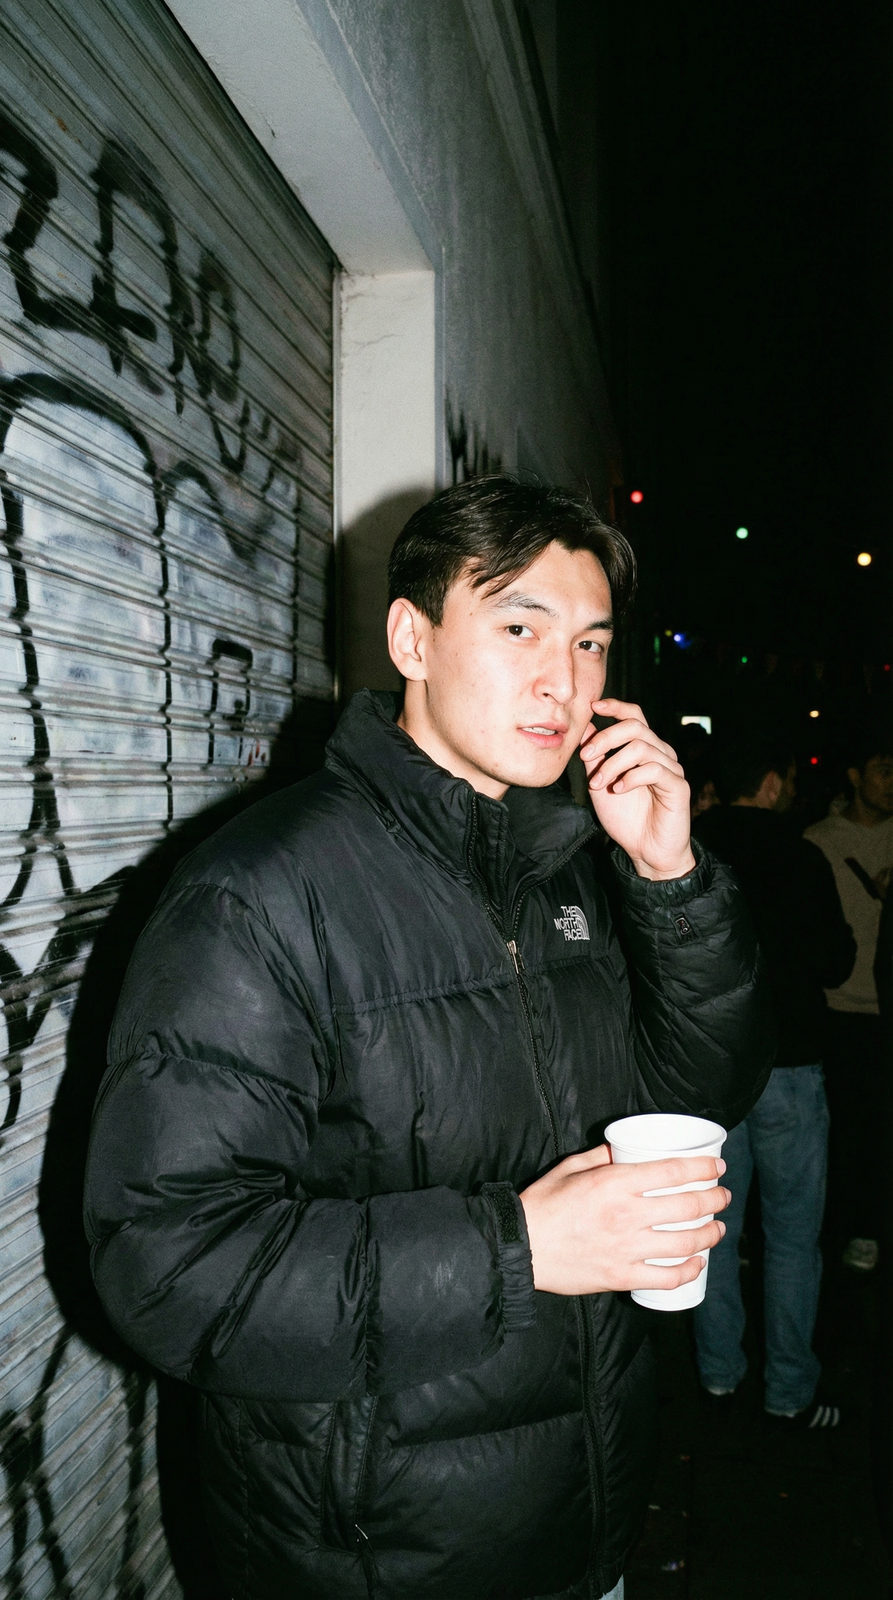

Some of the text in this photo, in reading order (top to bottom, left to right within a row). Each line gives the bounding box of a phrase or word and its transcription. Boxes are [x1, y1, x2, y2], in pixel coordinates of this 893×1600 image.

[561, 905, 577, 917] THE
[553, 917, 580, 930] NORTH
[563, 928, 582, 941] FACE
